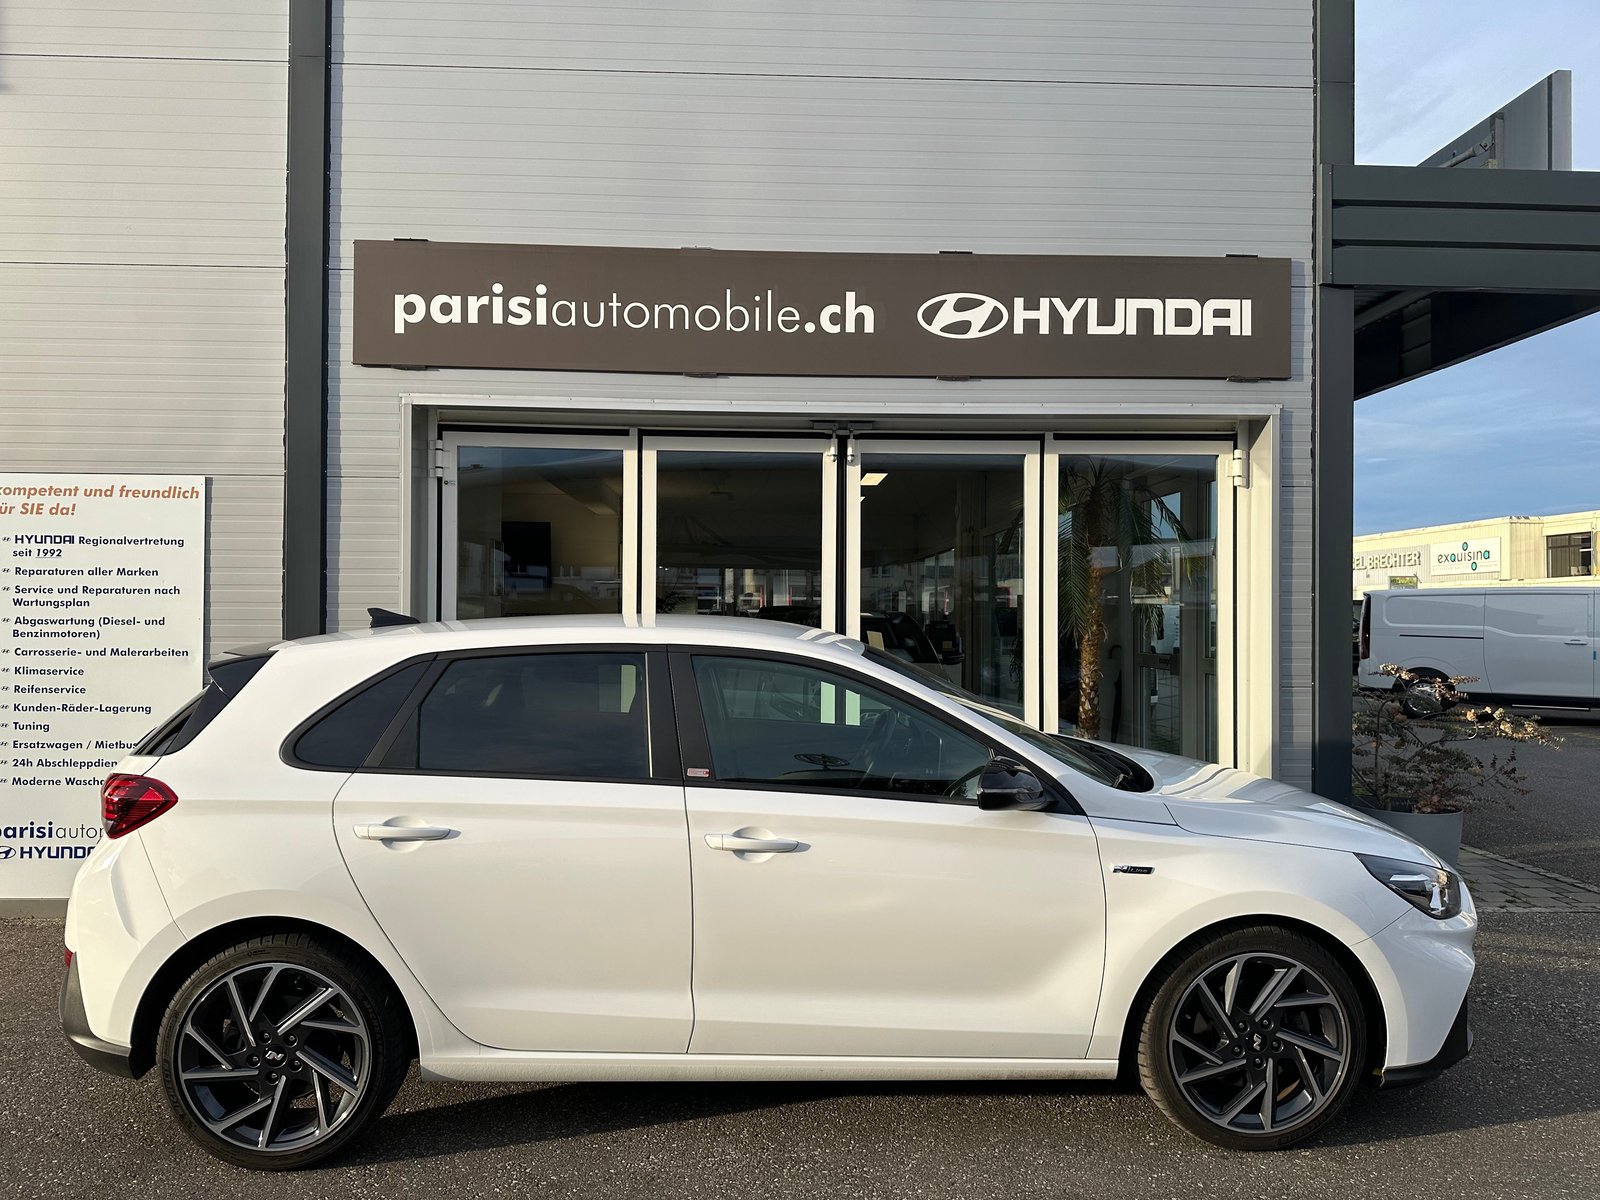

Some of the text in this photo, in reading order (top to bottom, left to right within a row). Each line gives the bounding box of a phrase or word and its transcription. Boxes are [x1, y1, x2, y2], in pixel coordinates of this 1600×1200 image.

[394, 282, 875, 334] parisiautomobile.ch
[1013, 297, 1252, 336] HYUNDAI
[0, 485, 200, 500] ompetent und freundlich
[20, 502, 45, 515] SIE
[49, 503, 76, 516] da!
[14, 535, 185, 547] HYUNDAI Regionalvertretung
[12, 548, 62, 557] seit 1992
[1368, 551, 1421, 569] BRECHTER
[14, 566, 159, 577] Reparaturen aller Marken
[14, 585, 181, 596] Service und Reparaturen nach
[12, 597, 90, 608] Wartungsplan
[14, 615, 165, 627] Abgaswartung (Diesel- und
[12, 629, 101, 640] Benzinmotoren)
[14, 647, 189, 657] Carrosserie- und Malerarbeiten
[14, 666, 85, 676] Klimaservice
[14, 684, 87, 694] Reifenservice
[13, 703, 152, 715] Kunden-Räder-Lagerung
[12, 721, 50, 733] Tuning
[12, 740, 83, 751] Ersatzwagen
[12, 758, 33, 768] 24h
[11, 777, 61, 787] Moderne
[0, 821, 104, 839] arisiauto
